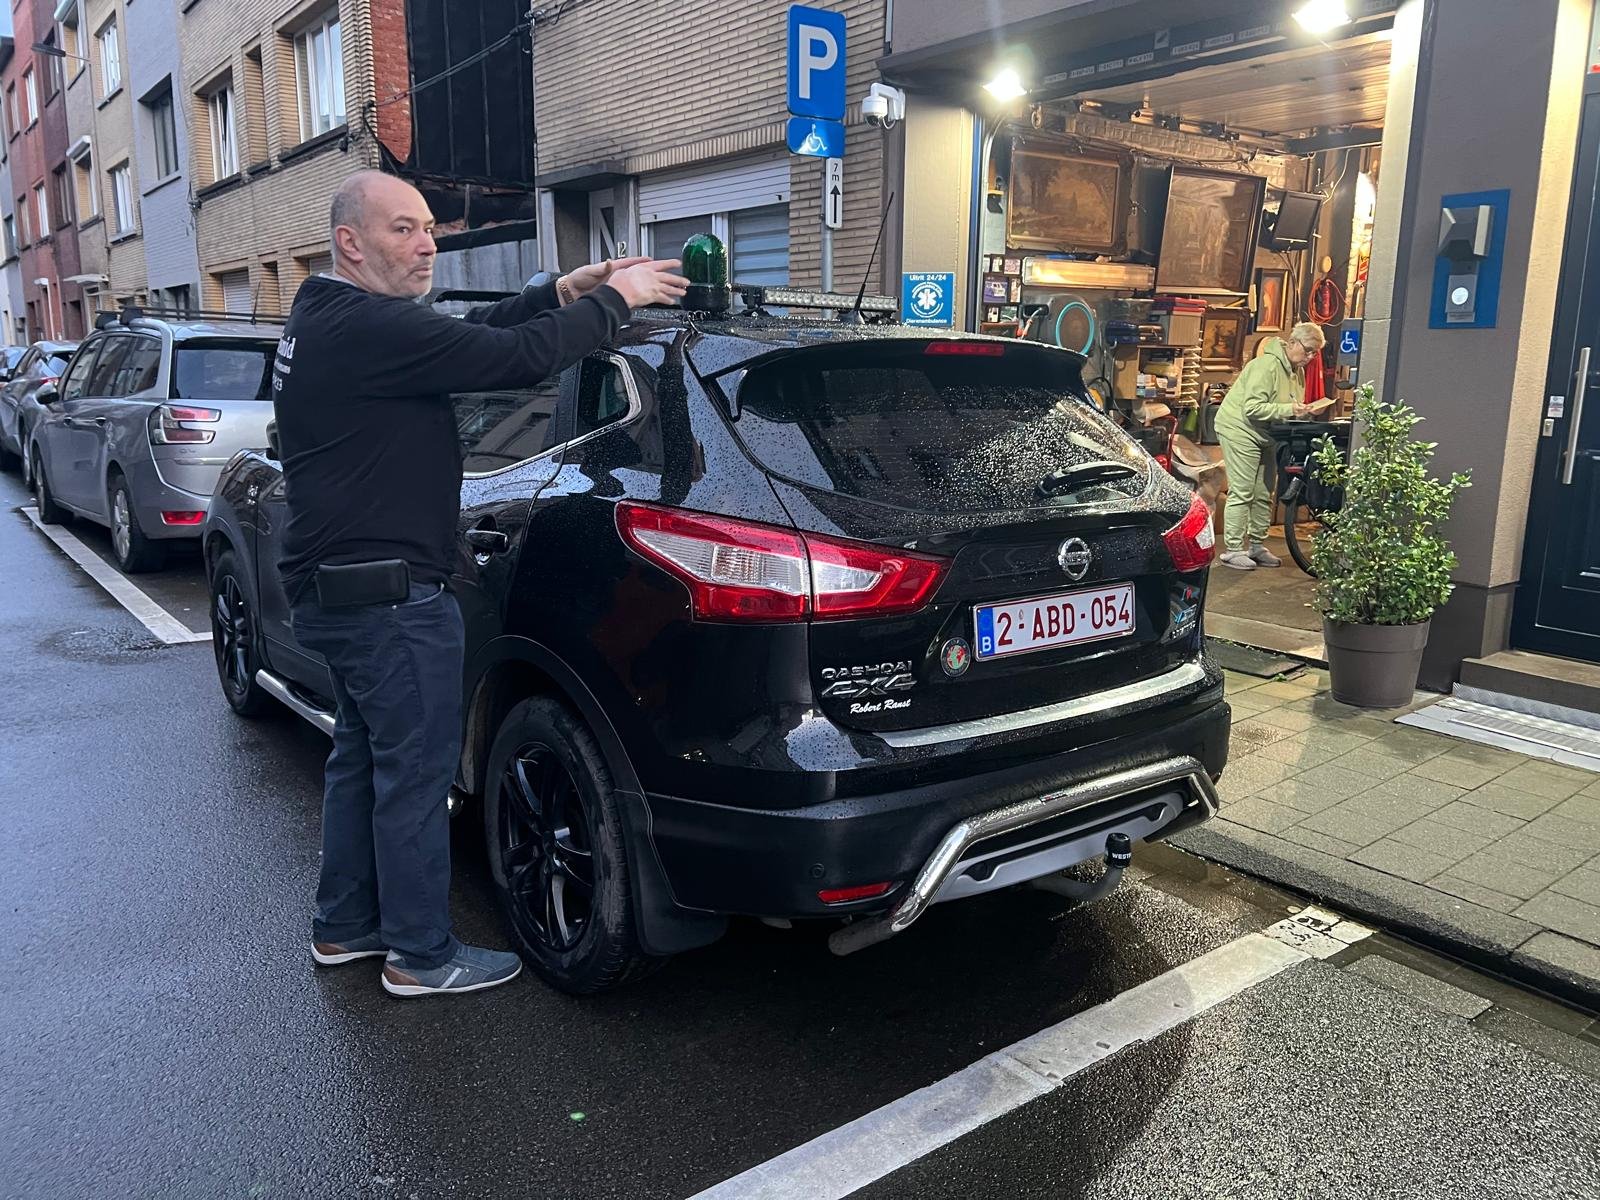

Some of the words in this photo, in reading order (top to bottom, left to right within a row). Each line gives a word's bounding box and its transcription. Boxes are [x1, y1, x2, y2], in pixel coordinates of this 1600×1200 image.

[799, 24, 838, 99] P
[833, 163, 838, 172] 7
[831, 174, 840, 182] m
[997, 592, 1130, 646] 2-ABD-054
[982, 636, 992, 652] B
[850, 701, 882, 714] Robert
[883, 698, 912, 710] Ranst
